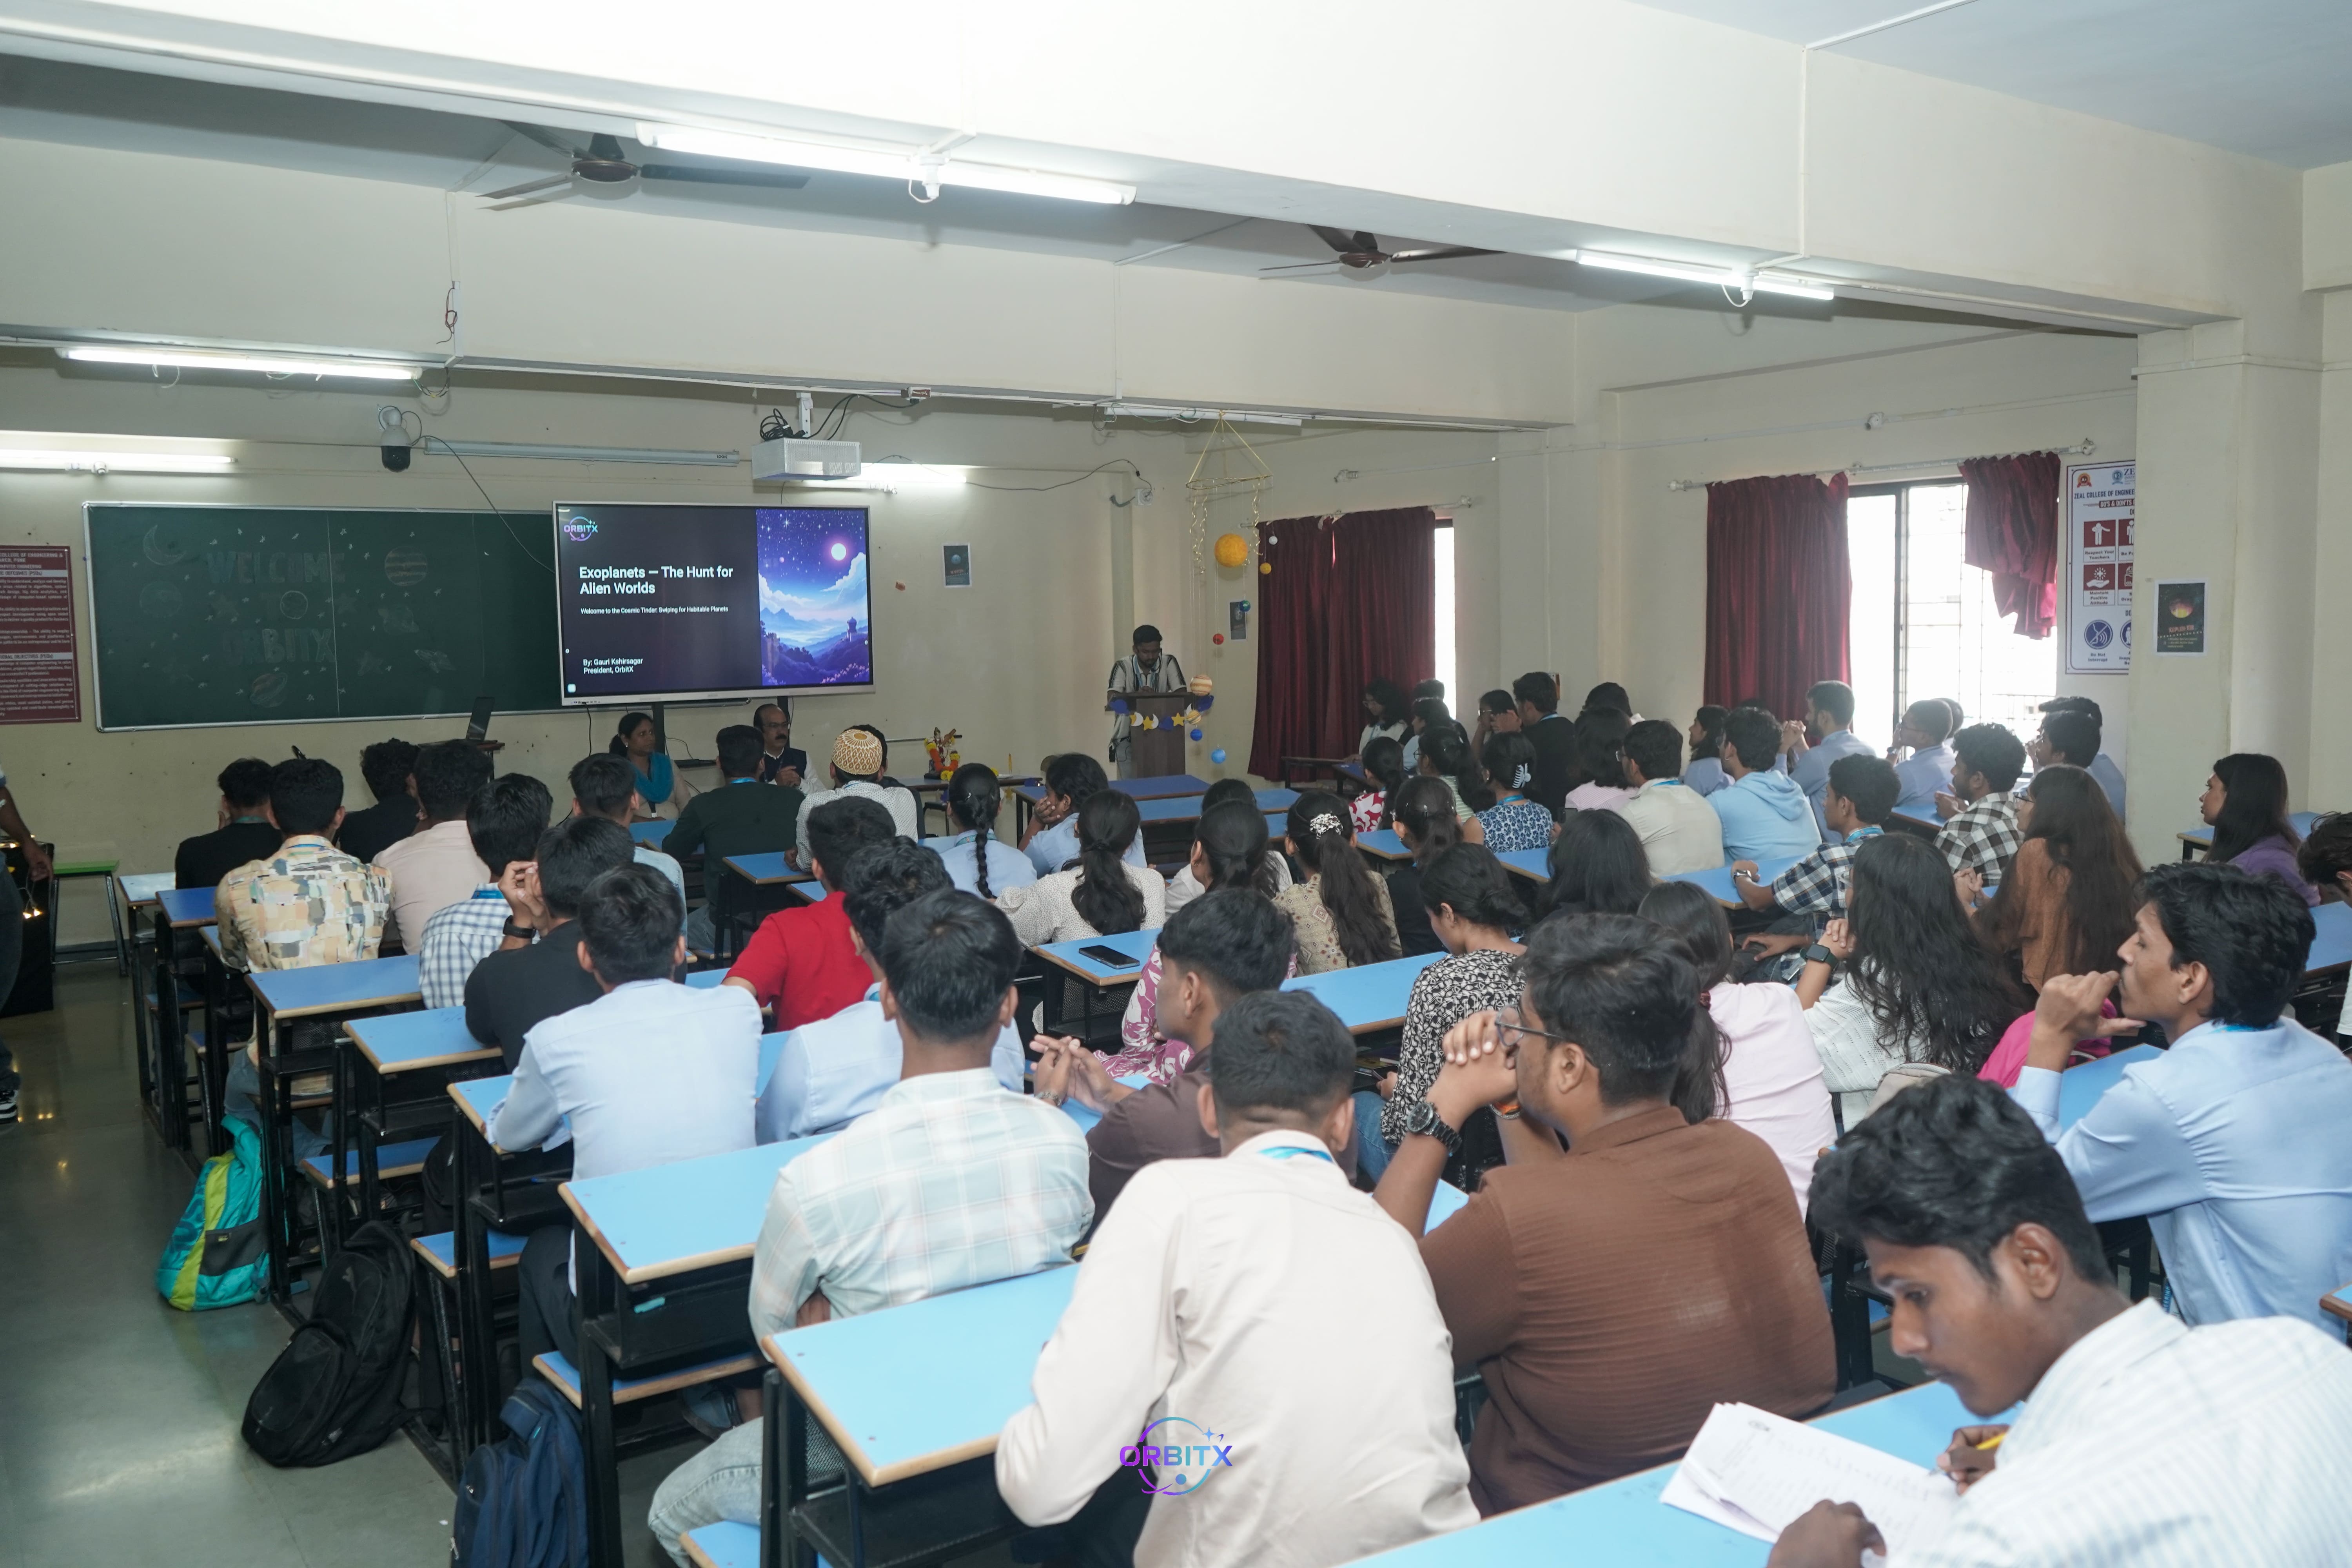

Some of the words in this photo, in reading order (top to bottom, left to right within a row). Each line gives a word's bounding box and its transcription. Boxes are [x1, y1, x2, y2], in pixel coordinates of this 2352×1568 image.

[564, 524, 598, 533] ORBITX
[207, 551, 346, 584] WELCOME
[579, 566, 645, 581] Exoplanets
[661, 566, 684, 578] The
[687, 566, 714, 578] Hunt
[717, 565, 733, 578] for
[580, 582, 611, 594] Alien
[614, 581, 655, 594] Worlds
[221, 628, 336, 665] ORBITX
[583, 659, 592, 667] By:
